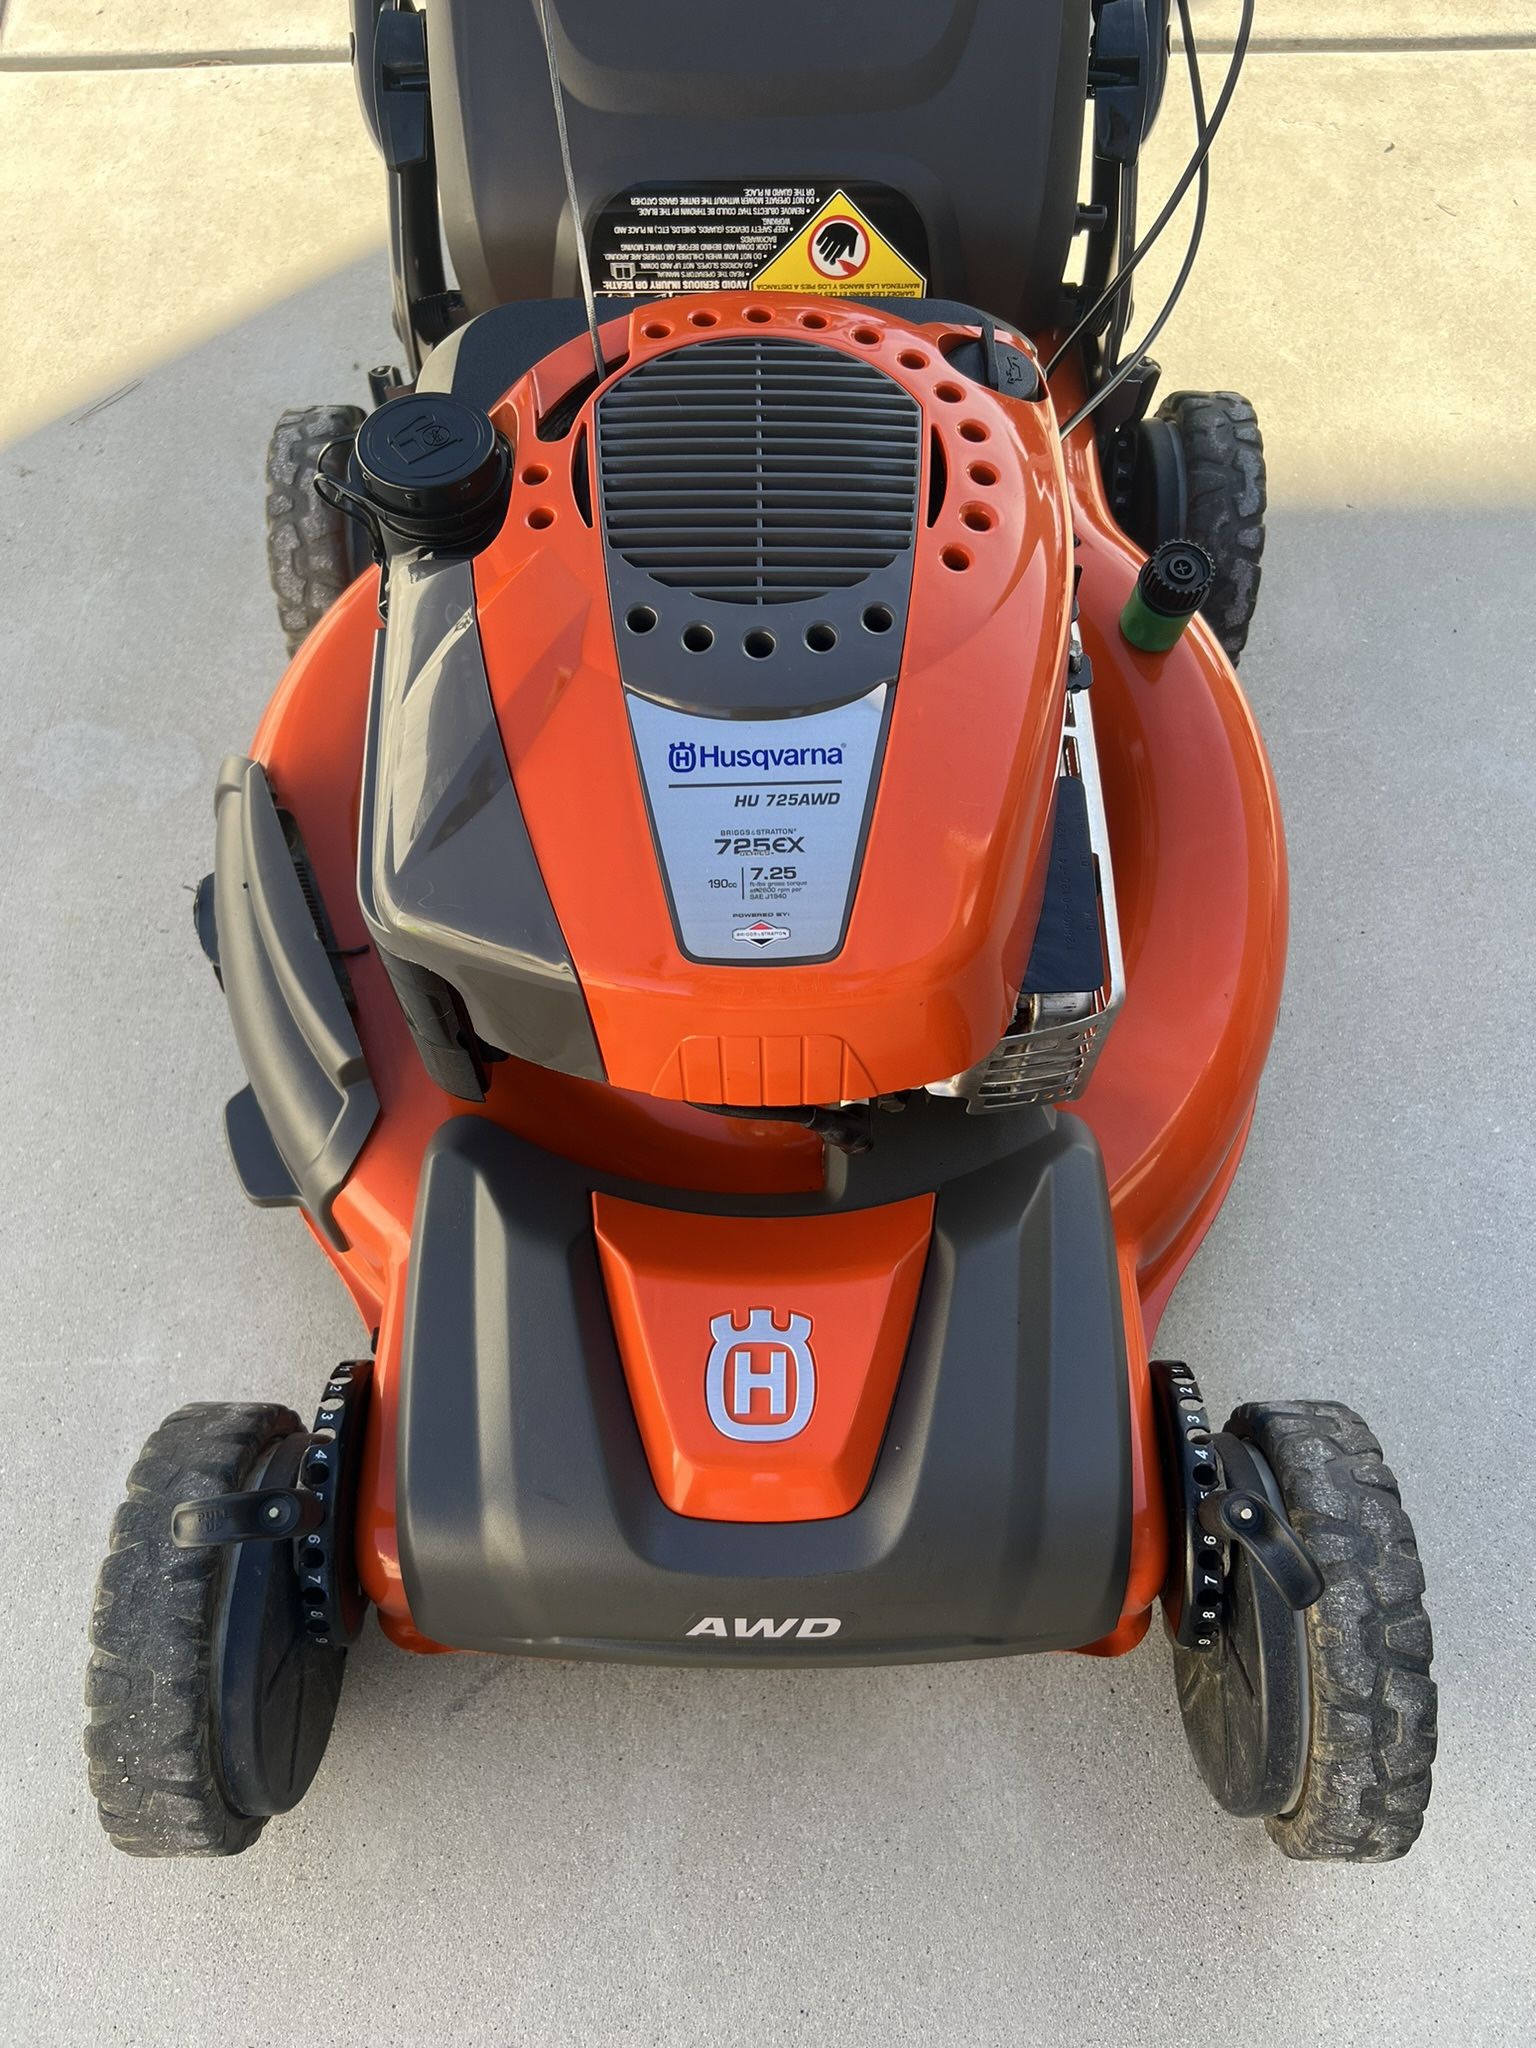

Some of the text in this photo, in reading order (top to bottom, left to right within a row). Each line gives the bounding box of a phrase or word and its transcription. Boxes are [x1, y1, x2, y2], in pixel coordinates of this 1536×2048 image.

[635, 280, 649, 289] OR
[650, 280, 681, 289] INJURY
[682, 280, 720, 289] SERIOUS
[721, 280, 748, 289] AVOID
[700, 745, 843, 771] Husqvarna
[734, 793, 841, 807] HU 725AWD
[750, 866, 797, 880] 7.25
[708, 878, 738, 889] 190cc
[330, 1385, 342, 1393] 2
[321, 1413, 333, 1421] 3
[1187, 1415, 1200, 1424] 3
[314, 1449, 327, 1460] 4
[1194, 1449, 1208, 1460] 4
[308, 1534, 320, 1545] 6
[1204, 1535, 1217, 1545] 6
[308, 1575, 321, 1584] 7
[1204, 1575, 1218, 1585] 7
[310, 1610, 323, 1618] 8
[1203, 1611, 1216, 1619] 8
[685, 1617, 842, 1638] AWD
